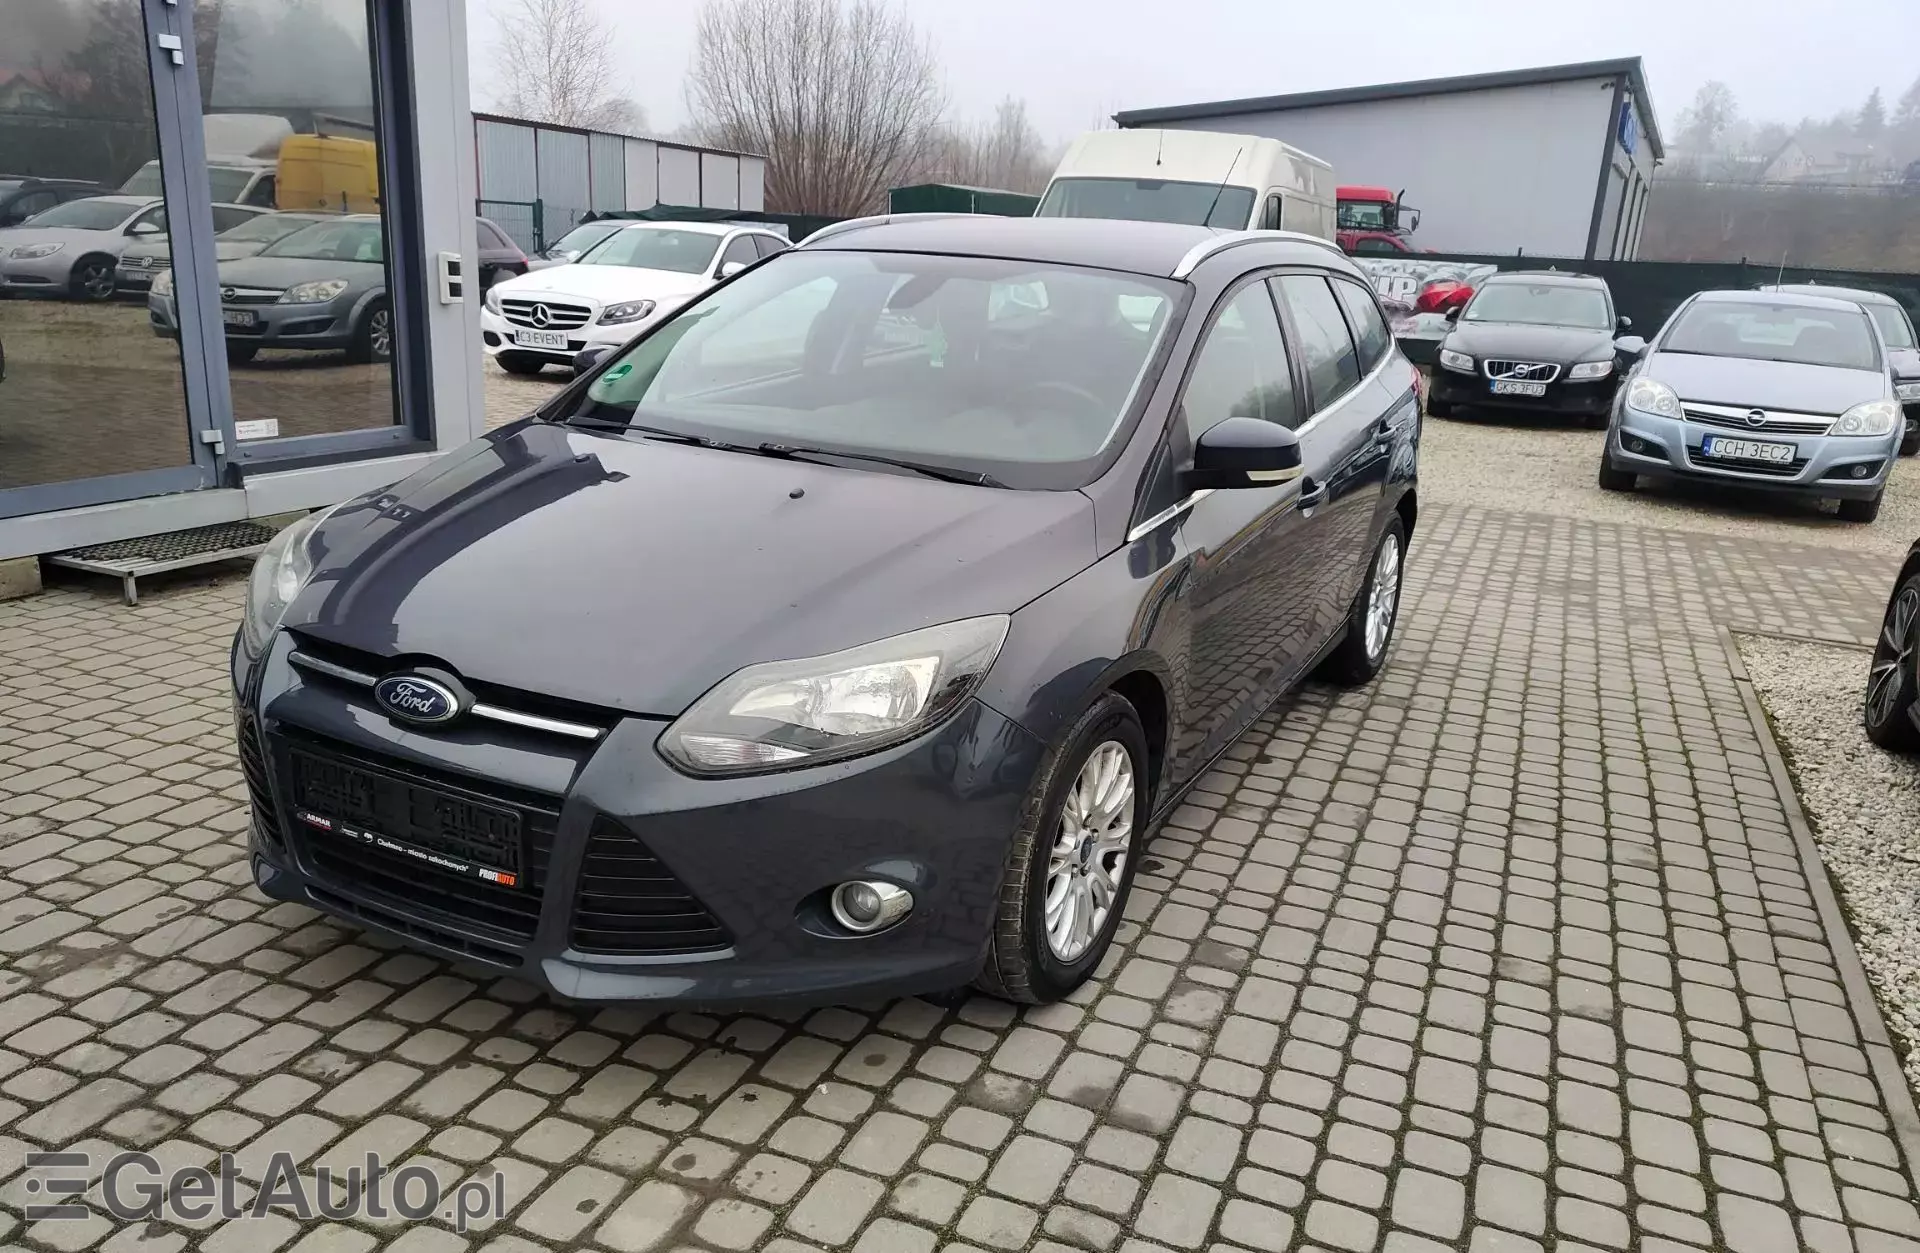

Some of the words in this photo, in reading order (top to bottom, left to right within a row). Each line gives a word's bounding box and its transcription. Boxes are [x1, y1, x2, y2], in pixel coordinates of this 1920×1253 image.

[520, 330, 531, 342] C3
[533, 332, 564, 345] EVENT
[1496, 381, 1517, 393] GKS
[1520, 383, 1545, 395] 3FU3
[1714, 439, 1746, 456] CCH
[1750, 443, 1791, 461] 3EC2
[389, 682, 436, 713] Ford
